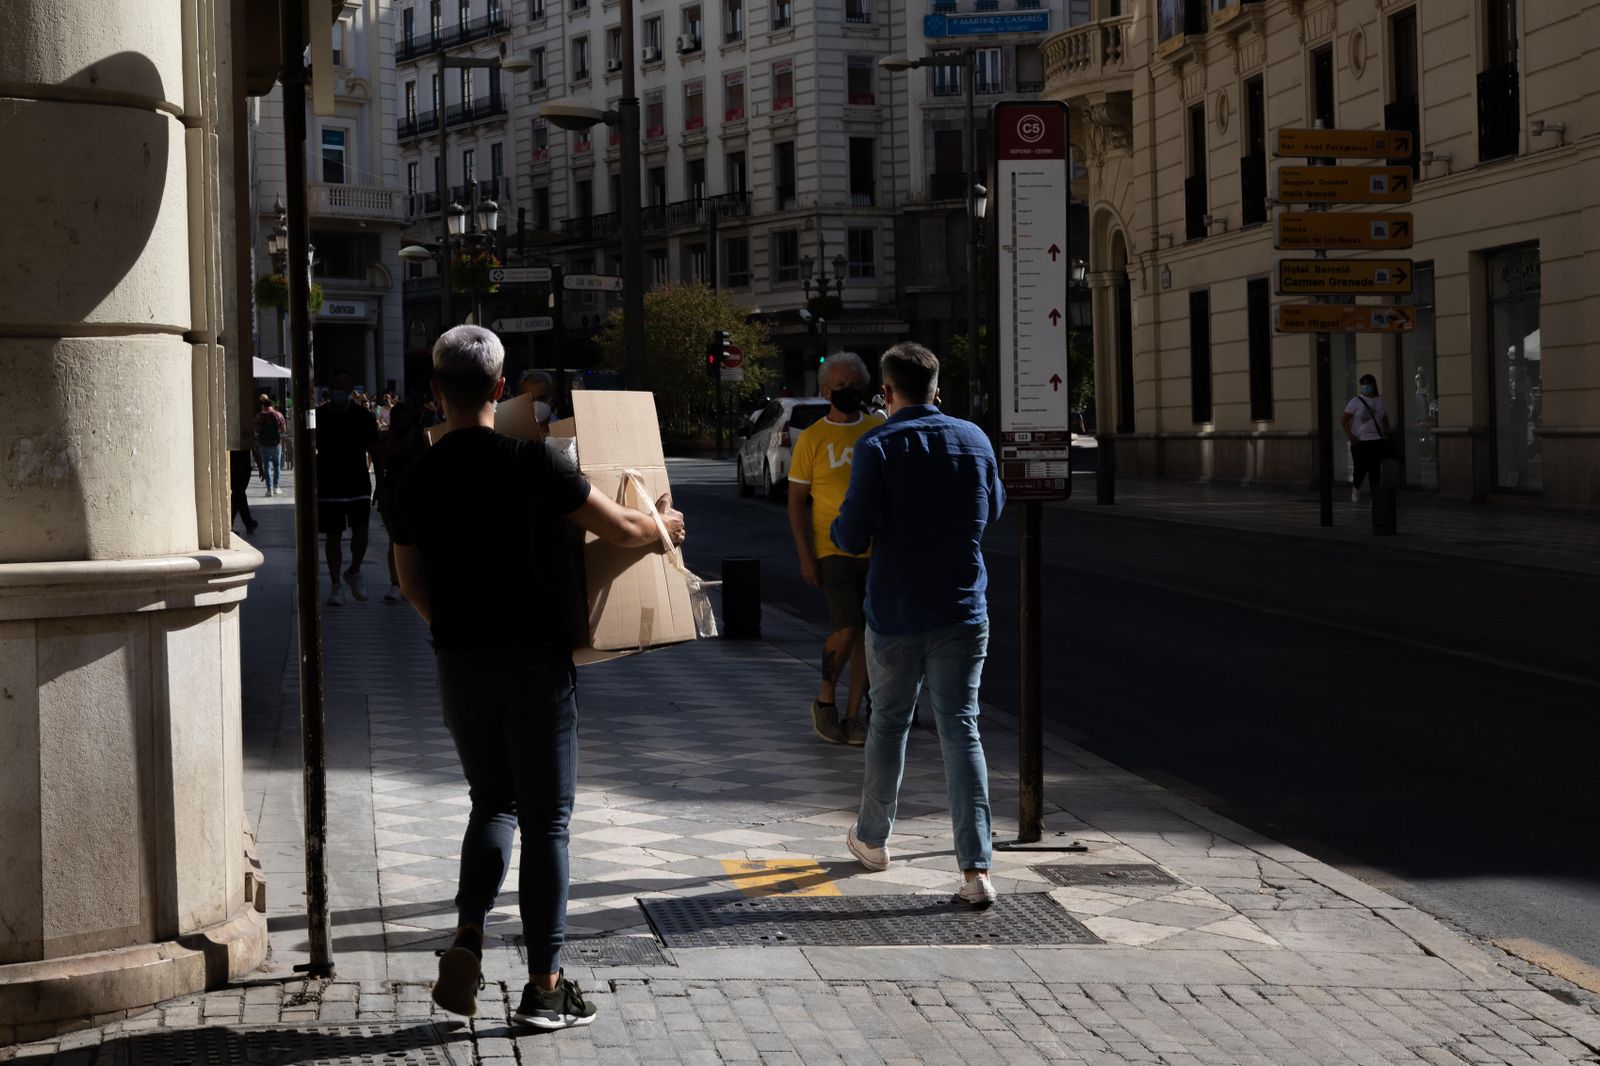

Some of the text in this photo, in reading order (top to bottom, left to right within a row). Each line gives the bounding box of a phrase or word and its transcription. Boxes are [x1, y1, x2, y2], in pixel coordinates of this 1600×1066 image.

[1023, 123, 1040, 134] C5
[1283, 265, 1309, 276] Hotel
[1283, 277, 1374, 287] Carmen Granada
